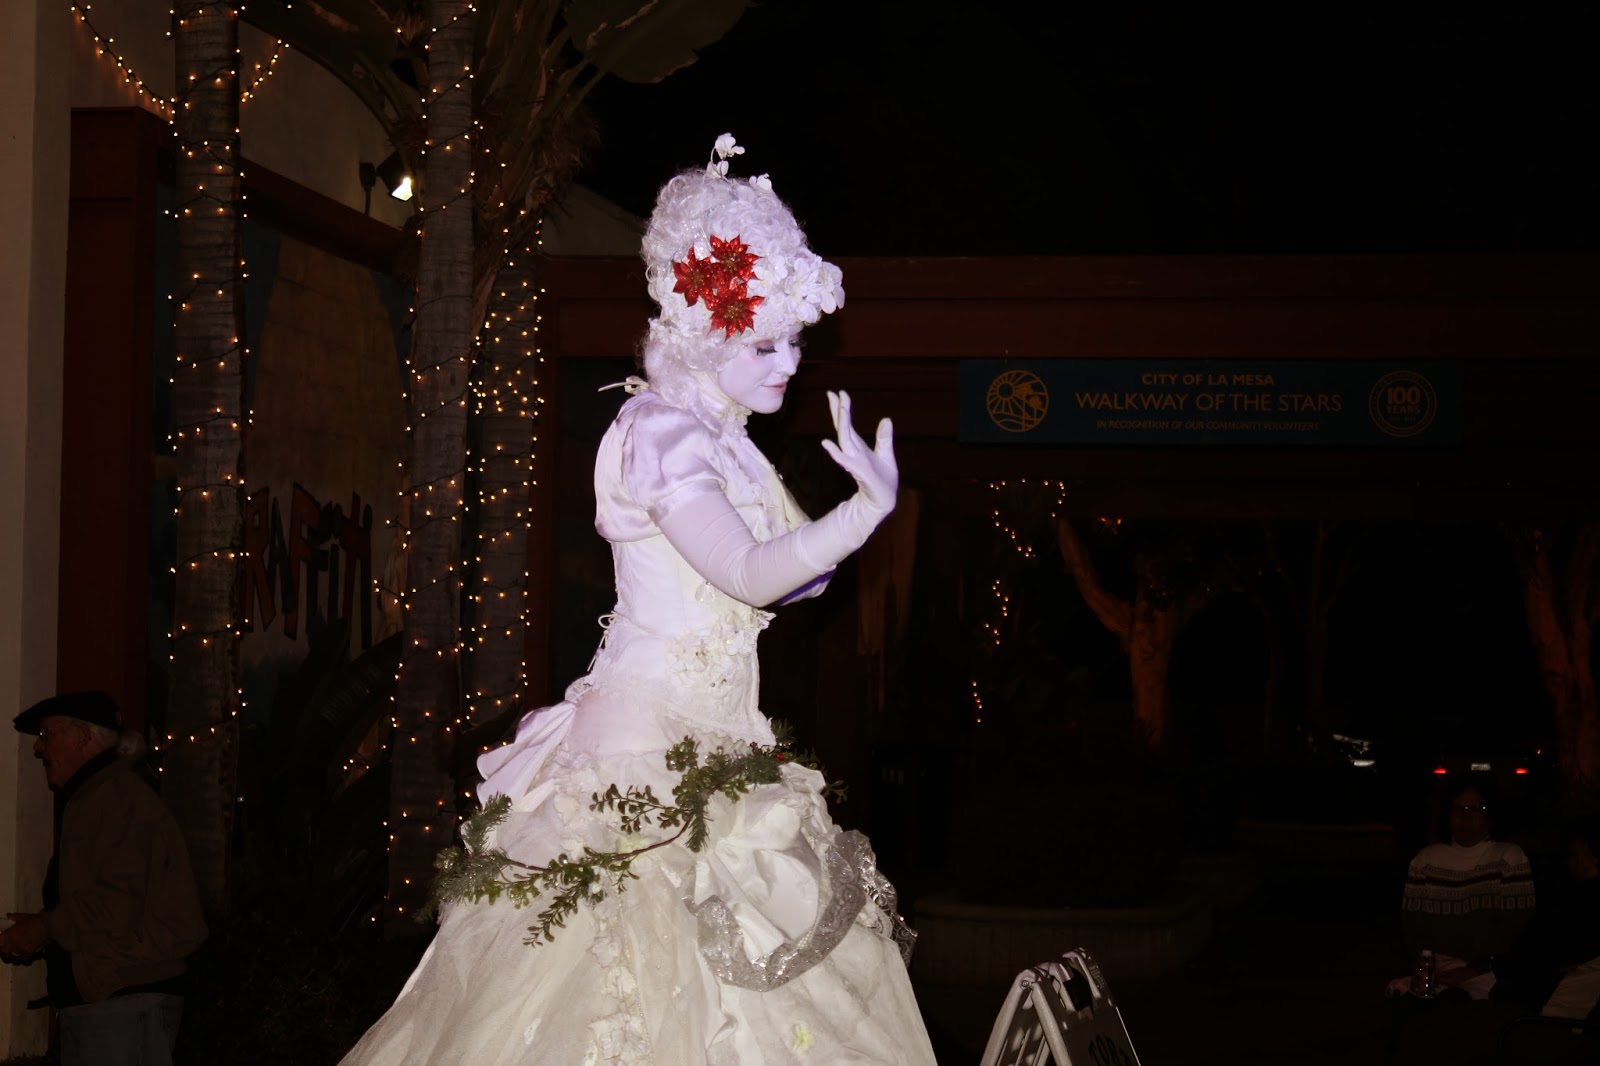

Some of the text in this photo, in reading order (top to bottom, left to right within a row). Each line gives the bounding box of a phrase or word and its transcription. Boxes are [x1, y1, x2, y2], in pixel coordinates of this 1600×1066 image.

[1141, 373, 1276, 386] CITY OF LA MESA
[1075, 391, 1343, 413] WALKWAY OF THE STARS
[1387, 385, 1421, 405] 100
[1108, 419, 1169, 430] RECOGNITION
[1170, 419, 1184, 431] OF
[1185, 420, 1204, 431] OUR
[1206, 420, 1261, 432] COMMUNITY
[1263, 421, 1320, 432] VOLUNTEERS
